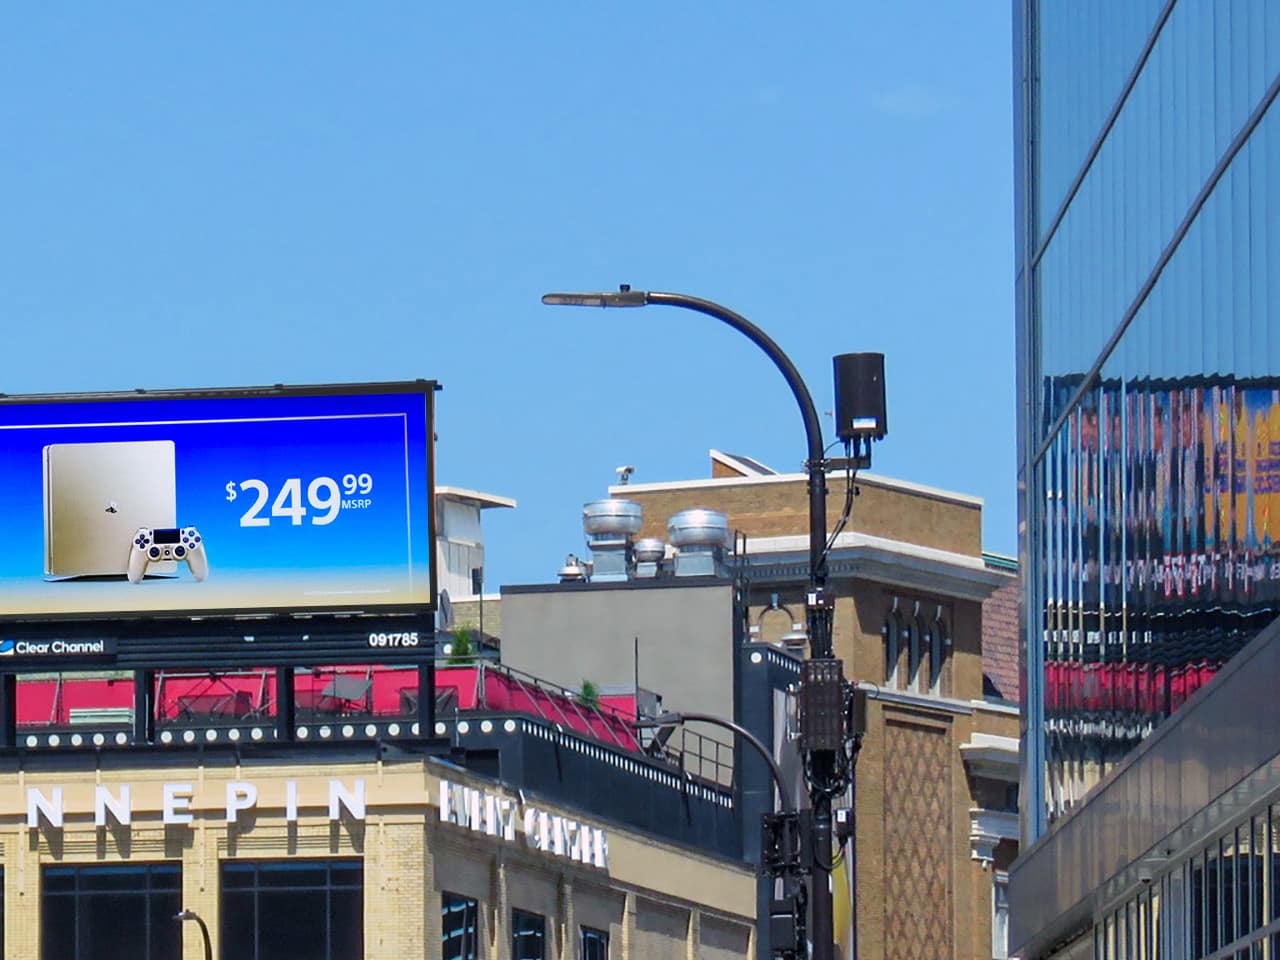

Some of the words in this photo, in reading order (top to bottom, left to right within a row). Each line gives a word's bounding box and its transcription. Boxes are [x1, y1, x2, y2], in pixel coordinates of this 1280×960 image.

[341, 499, 372, 510] MSRP
[15, 641, 50, 654] Clear
[51, 639, 104, 654] Channel
[368, 632, 419, 647] 091785
